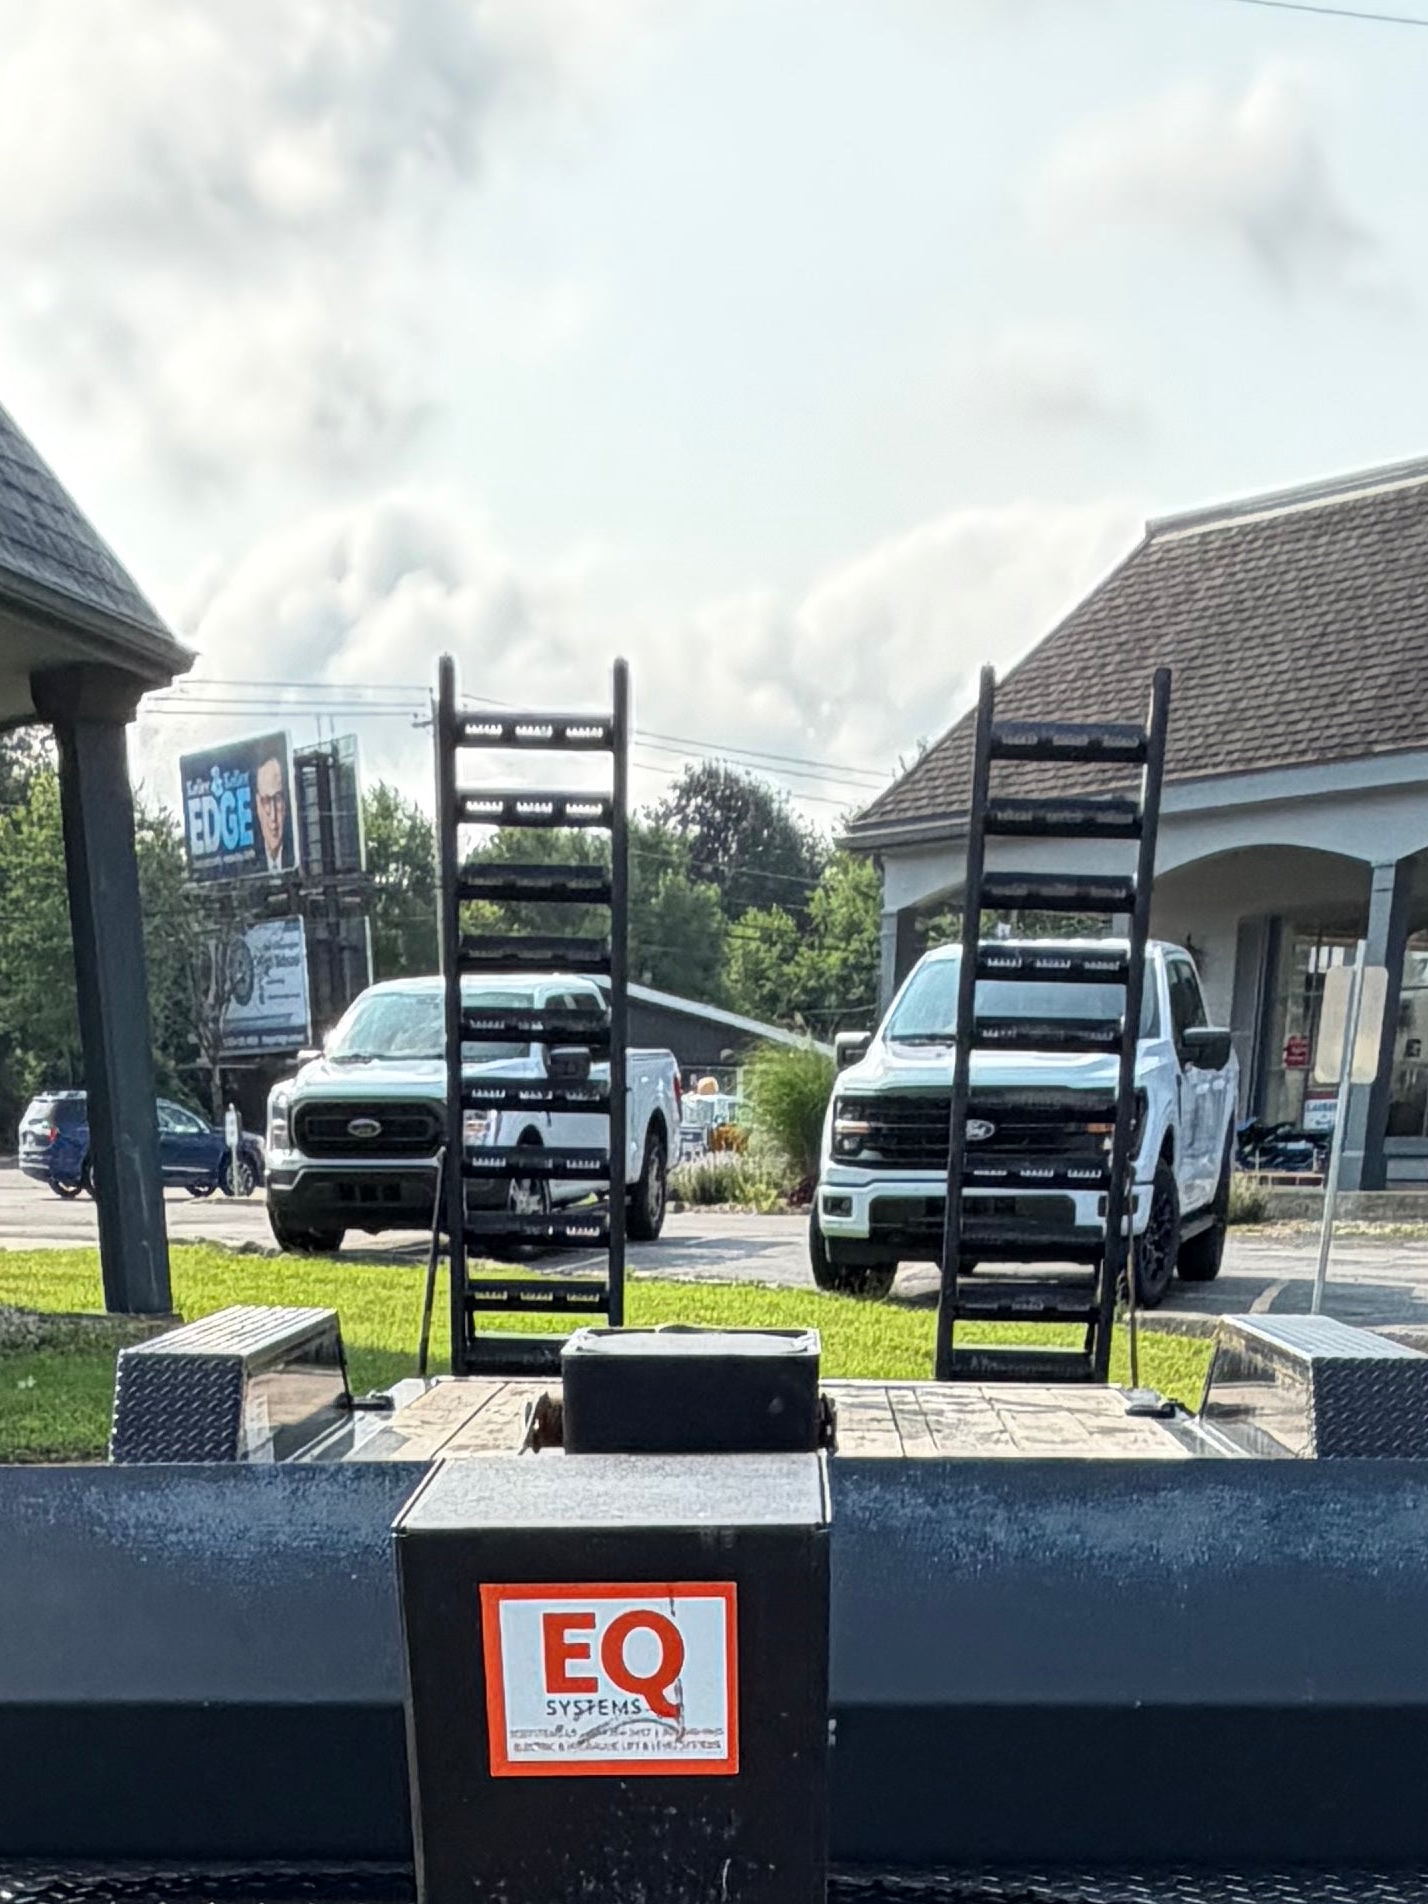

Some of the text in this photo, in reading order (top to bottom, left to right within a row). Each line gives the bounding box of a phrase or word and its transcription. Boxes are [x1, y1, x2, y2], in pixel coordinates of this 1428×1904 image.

[188, 786, 255, 856] EDGE
[542, 1609, 685, 1718] EQ
[546, 1699, 642, 1716] SYSTEMS
